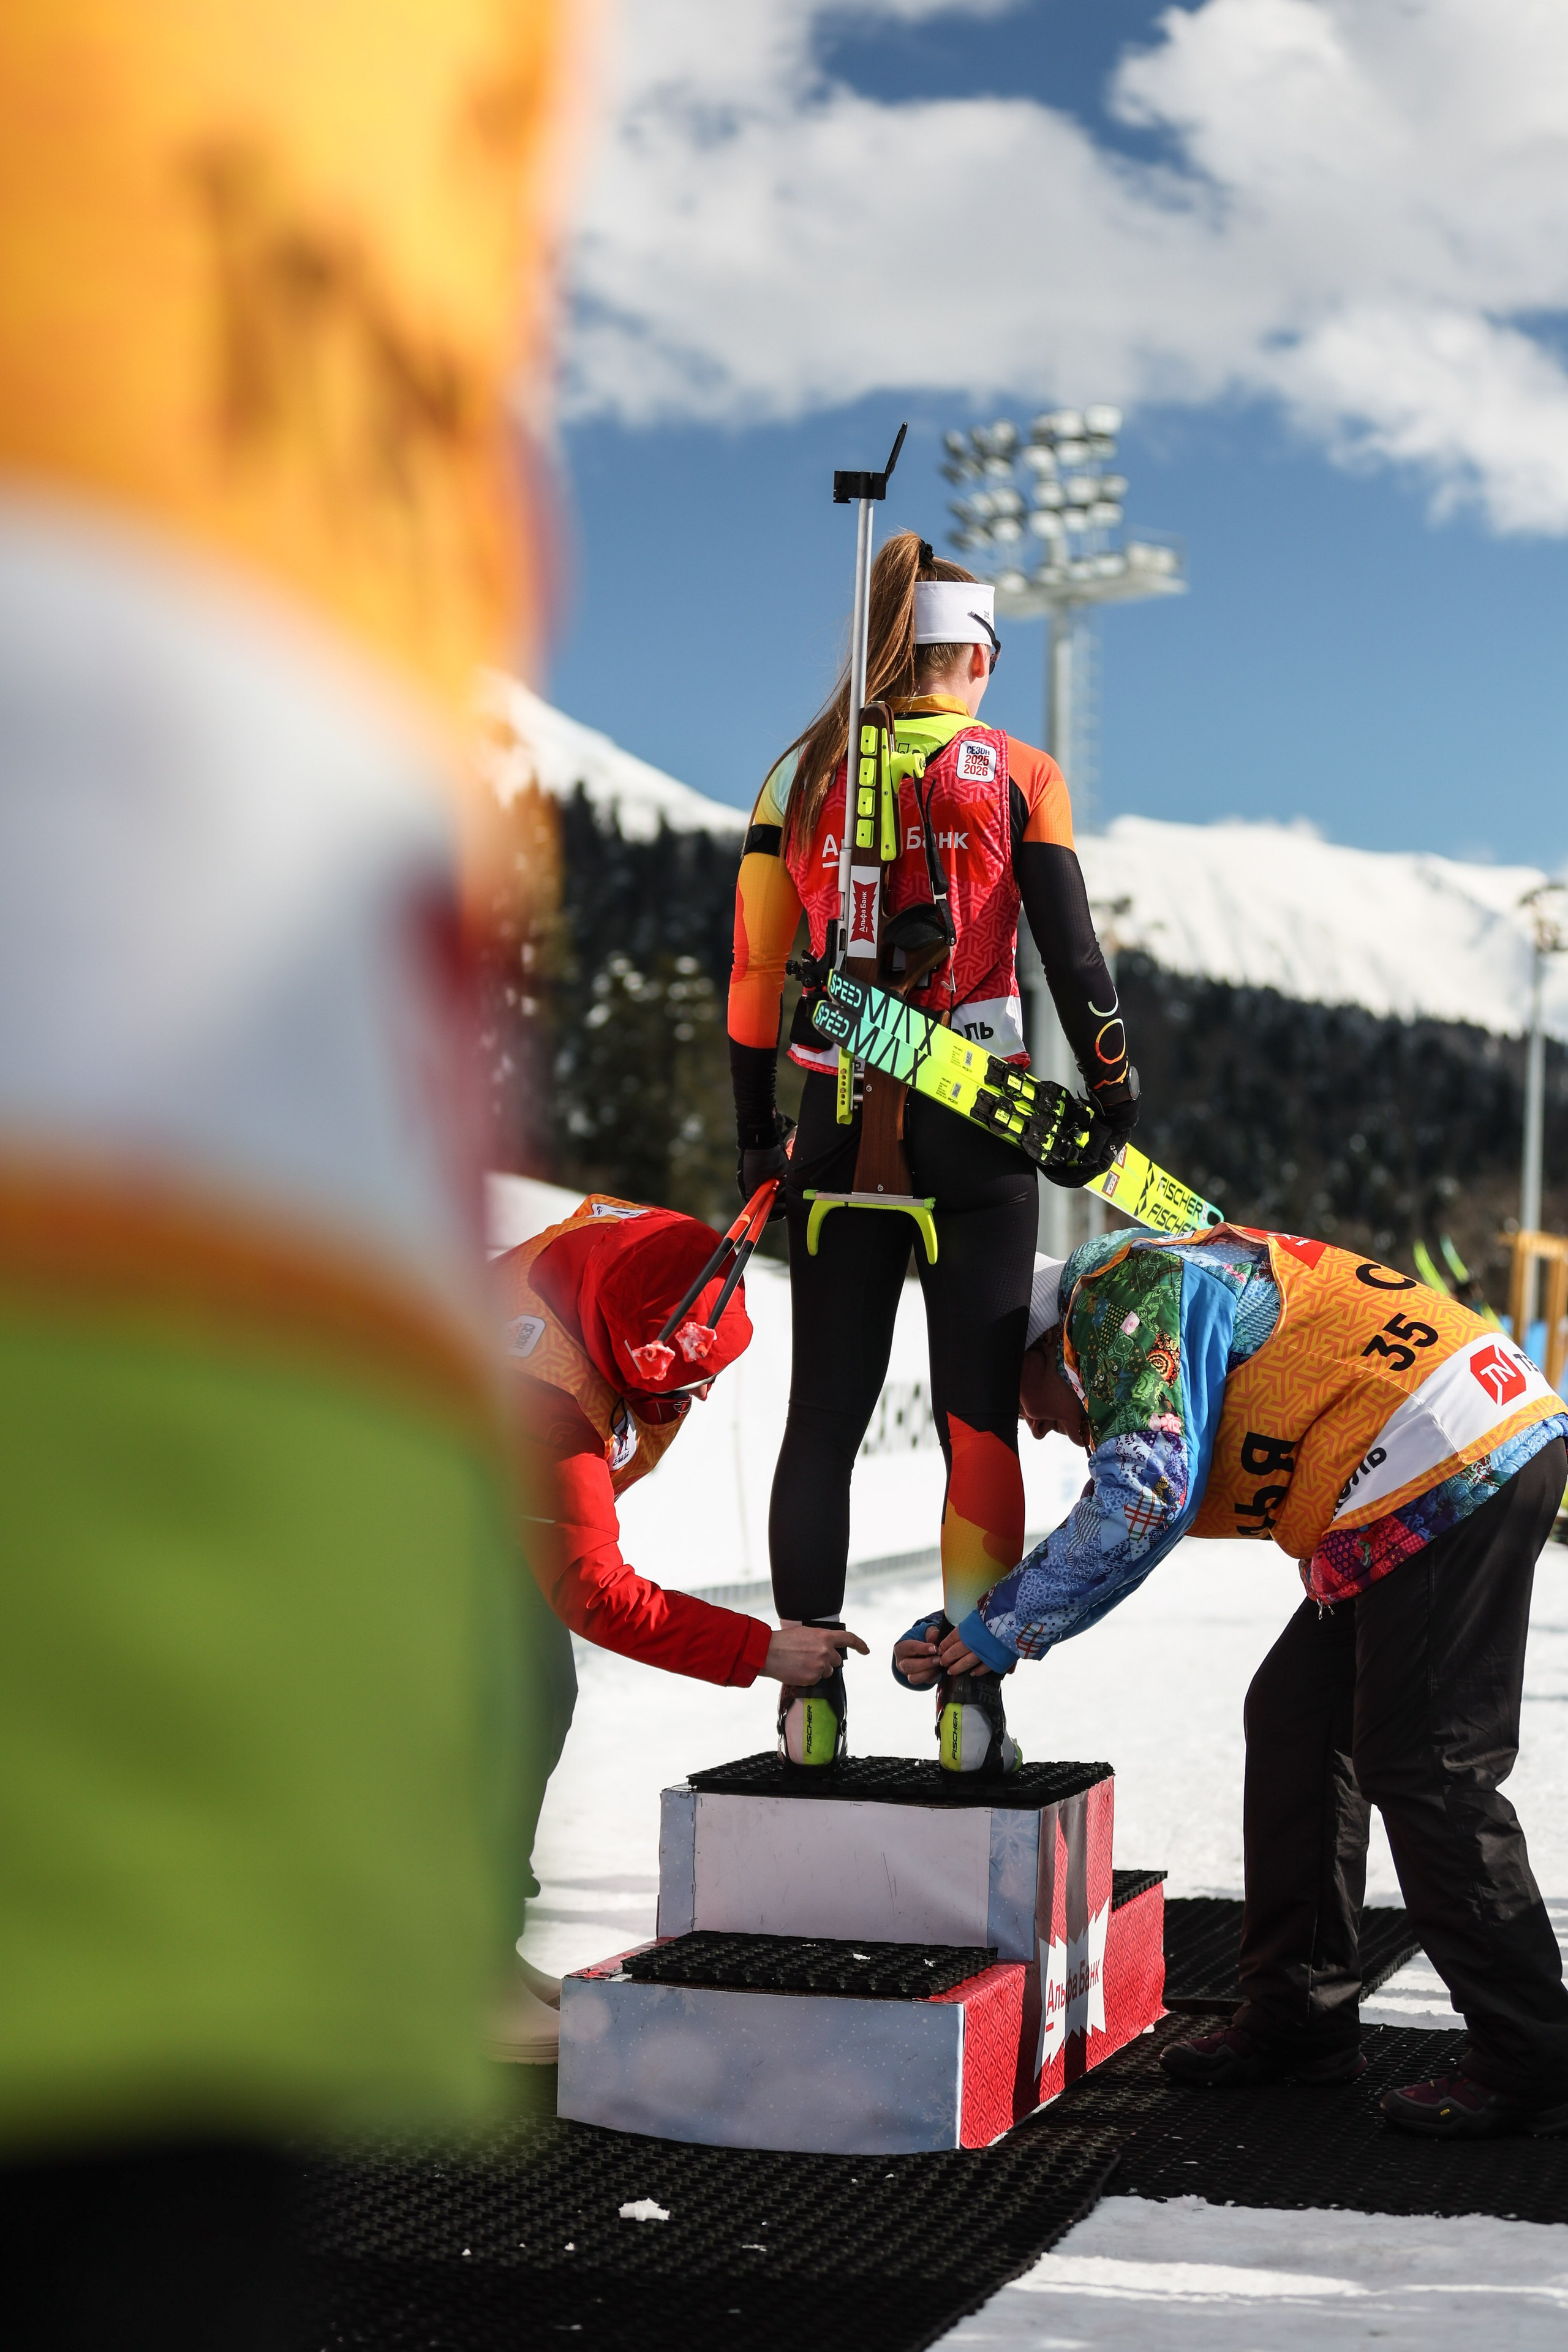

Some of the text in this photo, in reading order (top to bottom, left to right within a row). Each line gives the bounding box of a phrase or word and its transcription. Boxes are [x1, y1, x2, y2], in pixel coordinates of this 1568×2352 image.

[965, 755, 989, 766] 2025
[967, 746, 990, 755] СЕЗОН
[963, 764, 988, 776] 2026
[907, 826, 969, 850] Бнк
[830, 974, 938, 1057] SPEED MAX
[815, 1005, 928, 1088] SPEED MAX
[1156, 1177, 1203, 1220] FISCHER
[1147, 1204, 1197, 1236] FISCHE
[1360, 1313, 1438, 1371] 35
[1046, 1959, 1101, 2016] Альфа Банк
